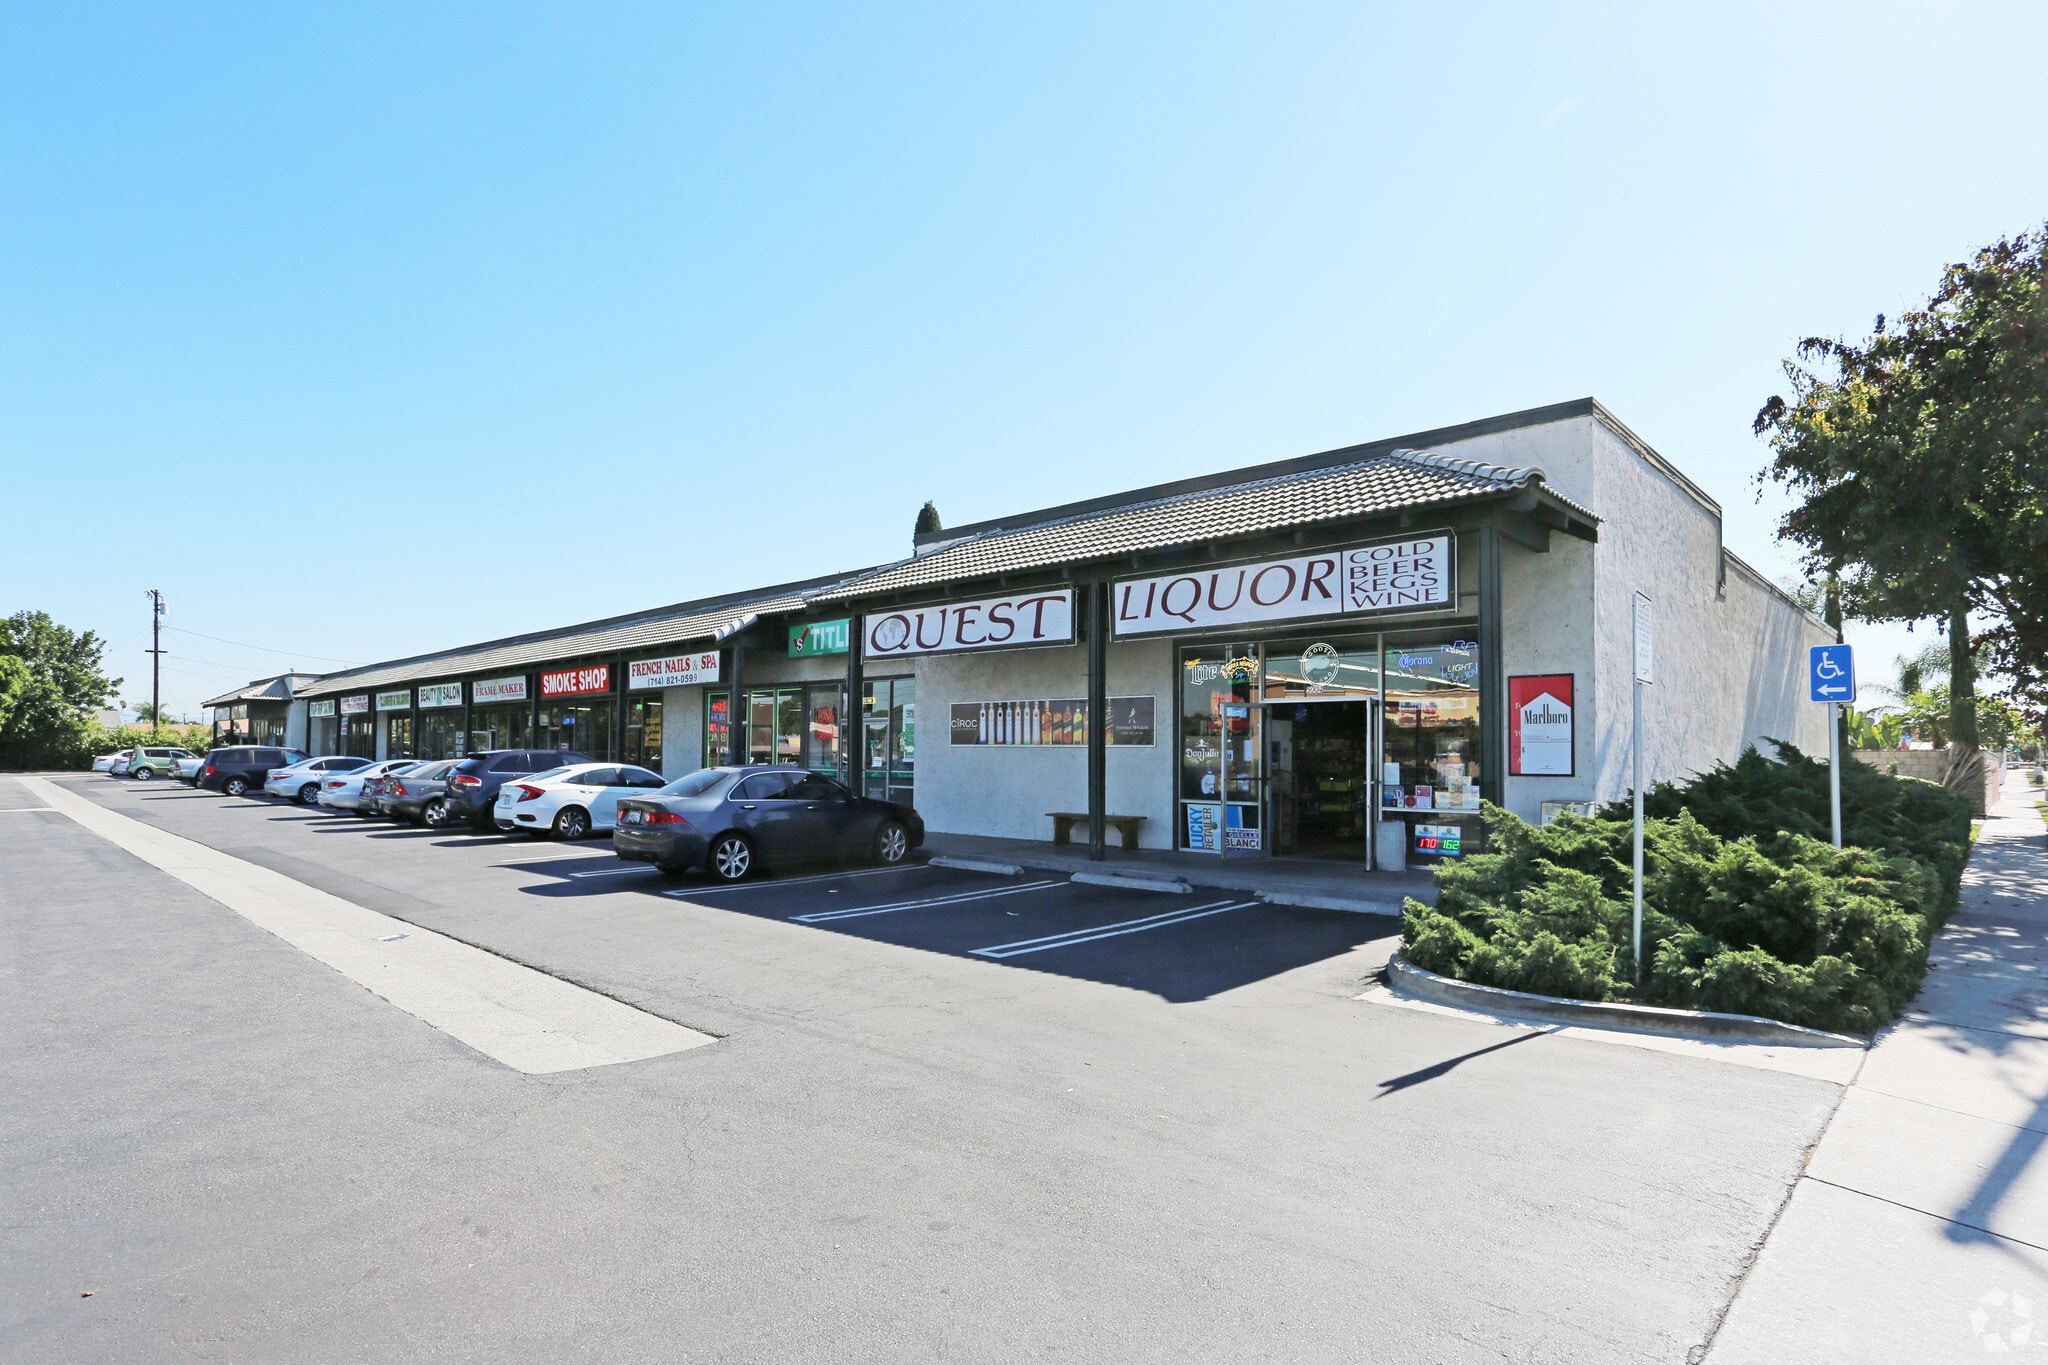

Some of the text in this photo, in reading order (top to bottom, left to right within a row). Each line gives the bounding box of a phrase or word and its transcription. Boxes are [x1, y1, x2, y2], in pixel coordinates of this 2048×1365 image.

[1349, 541, 1435, 564] COLD
[1350, 557, 1435, 580] BEER
[1119, 559, 1336, 623] LIQUOR
[1350, 571, 1439, 595] KEGS
[1350, 587, 1439, 608] WINE
[870, 595, 1067, 652] QUEST
[1308, 646, 1332, 656] GOOSE
[1398, 655, 1433, 668] Corona
[631, 654, 717, 677] FRENCH NAILS & SPA
[1190, 664, 1218, 686] Lite
[1447, 662, 1473, 673] LIGHT
[475, 686, 497, 697] FRAME
[499, 682, 524, 694] MAKER
[543, 667, 607, 694] SMOKE SHOP
[647, 673, 698, 687] (714) 821-0599
[420, 687, 437, 702] BEAUTY
[443, 685, 461, 700] SALON
[1524, 703, 1568, 725] Marlboro
[1189, 807, 1205, 850] LUCKY
[1203, 807, 1215, 850] RETAILER
[1419, 838, 1437, 849] 170
[1443, 839, 1460, 850] 162
